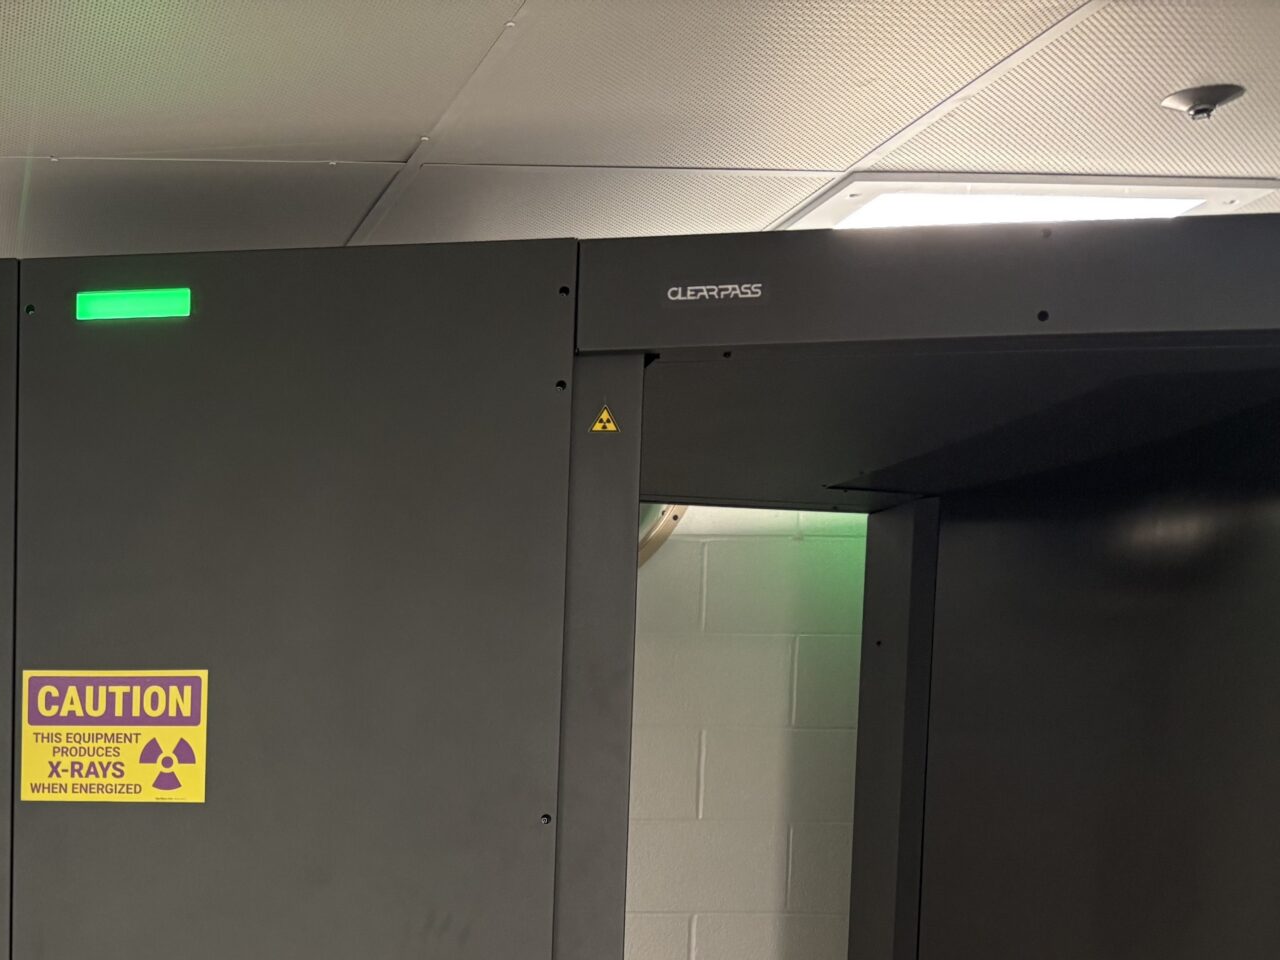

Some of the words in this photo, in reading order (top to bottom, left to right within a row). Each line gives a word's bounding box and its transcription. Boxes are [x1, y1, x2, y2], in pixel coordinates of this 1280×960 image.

[667, 283, 762, 301] CLEARPASS
[37, 685, 192, 718] CAUTION
[33, 732, 63, 744] THIS
[65, 732, 141, 744] EQUIPMENT
[52, 746, 120, 758] PRODUCES
[47, 760, 125, 779] X-RAYS
[29, 782, 68, 794] WHEN
[71, 783, 142, 795] ENERGIZED
